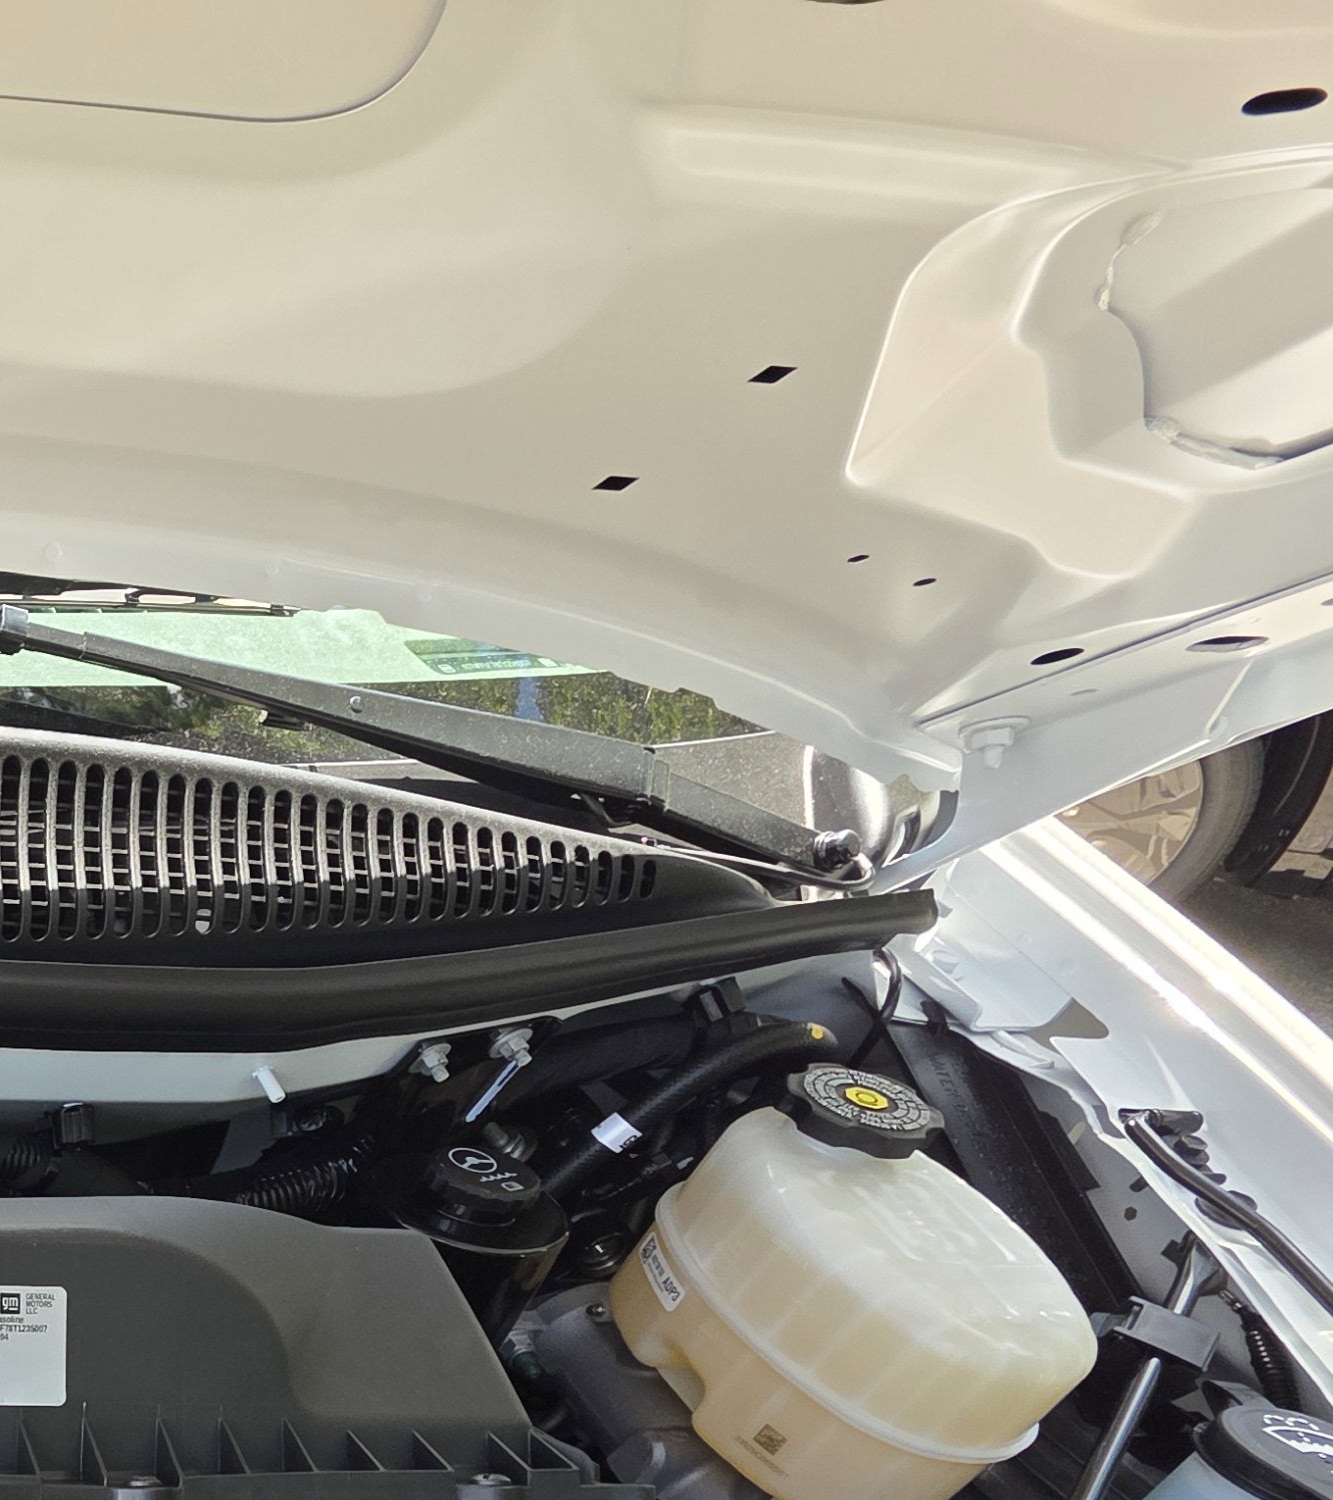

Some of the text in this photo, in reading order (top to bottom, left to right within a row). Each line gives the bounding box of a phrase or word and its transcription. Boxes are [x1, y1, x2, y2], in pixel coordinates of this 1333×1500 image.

[25, 1293, 55, 1301] GENERAL
[2, 1296, 19, 1311] gm
[25, 1300, 53, 1308] MOTORS
